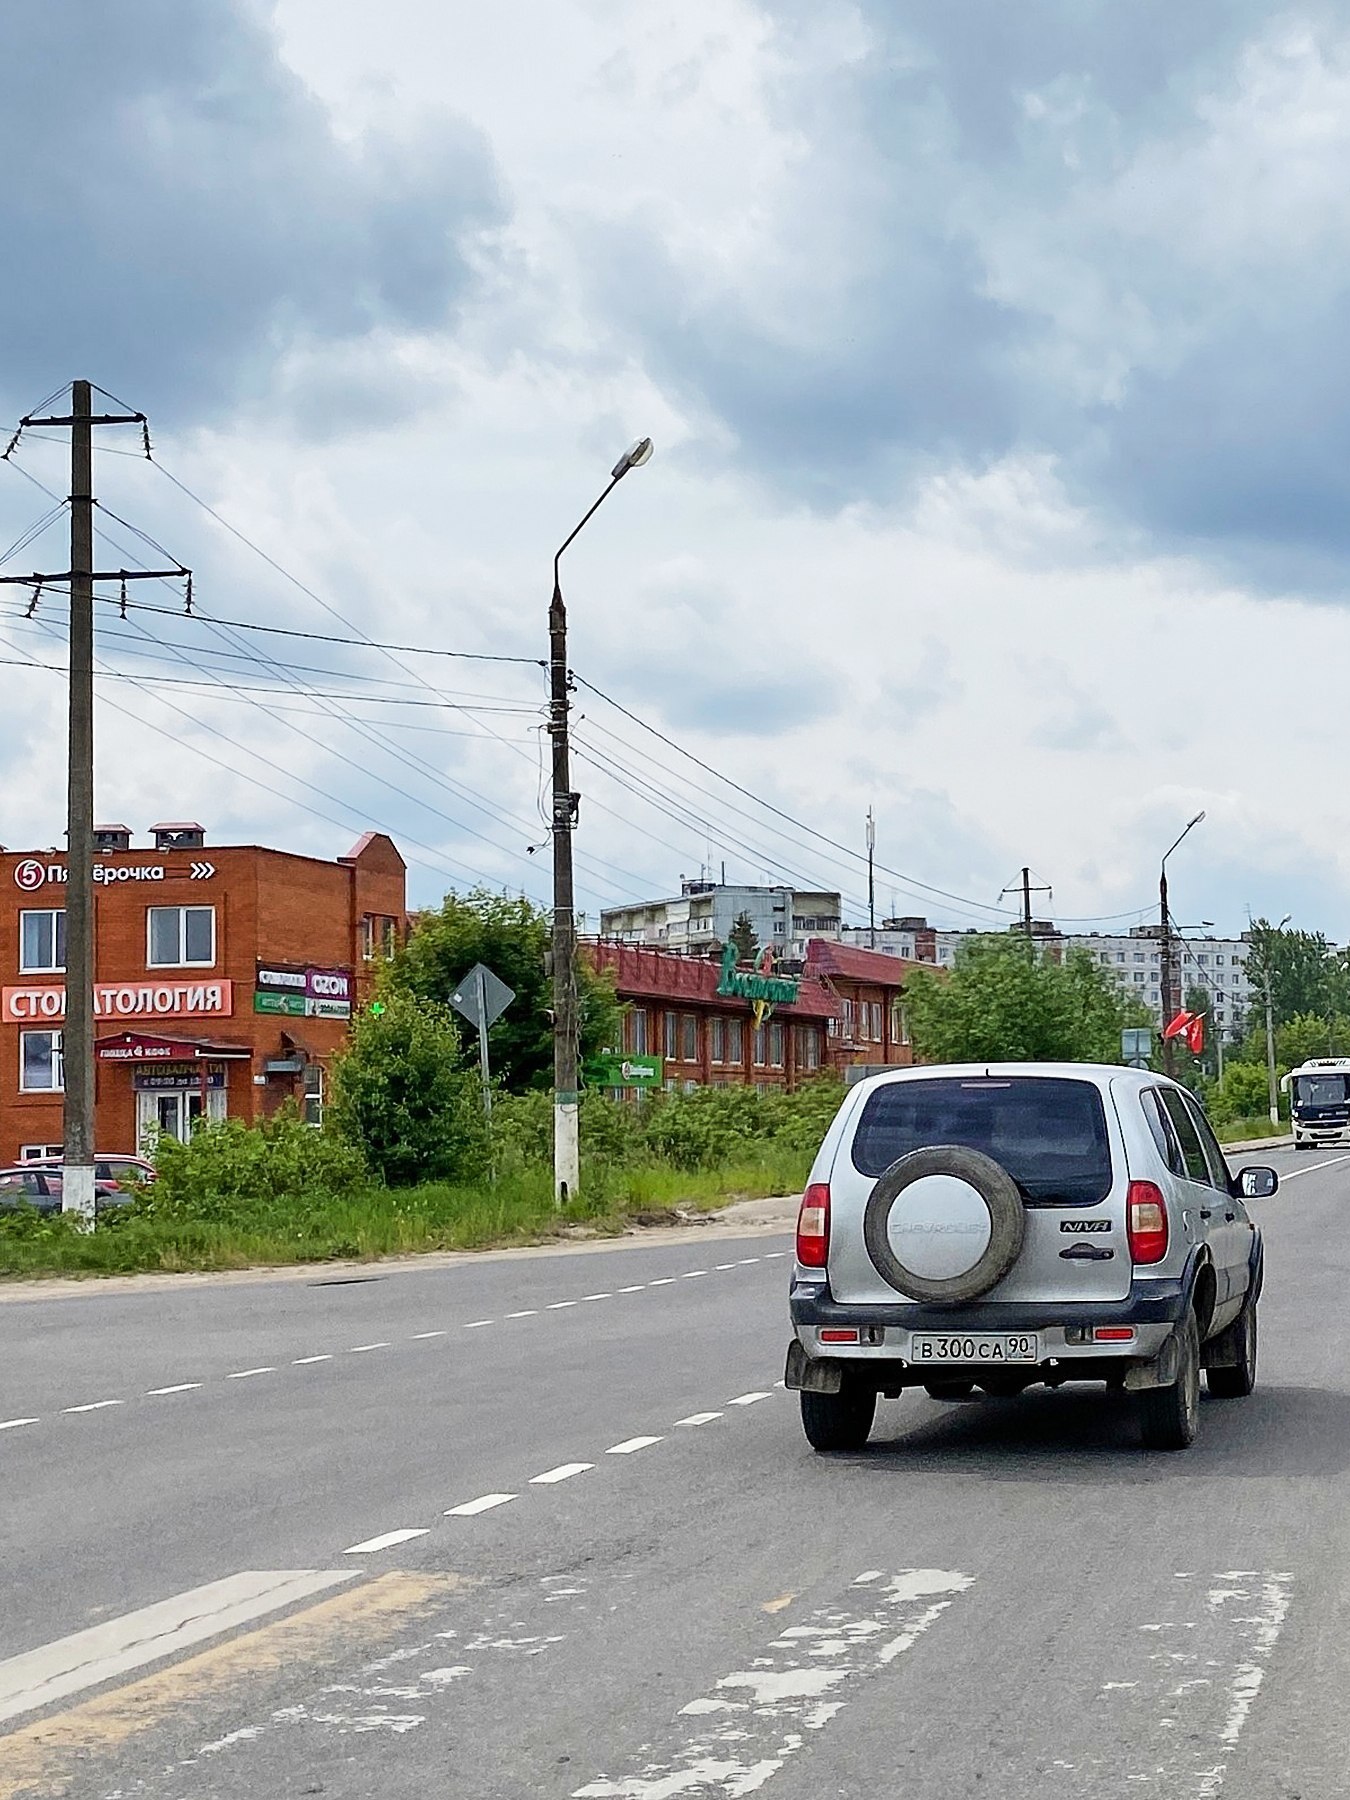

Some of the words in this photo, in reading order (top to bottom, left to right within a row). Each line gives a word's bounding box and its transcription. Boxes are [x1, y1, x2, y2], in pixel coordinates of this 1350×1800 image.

[47, 864, 164, 886] Пяёрочка
[9, 985, 223, 1017] СТОТОЛОГИЯ
[1062, 1221, 1109, 1232] NIVA
